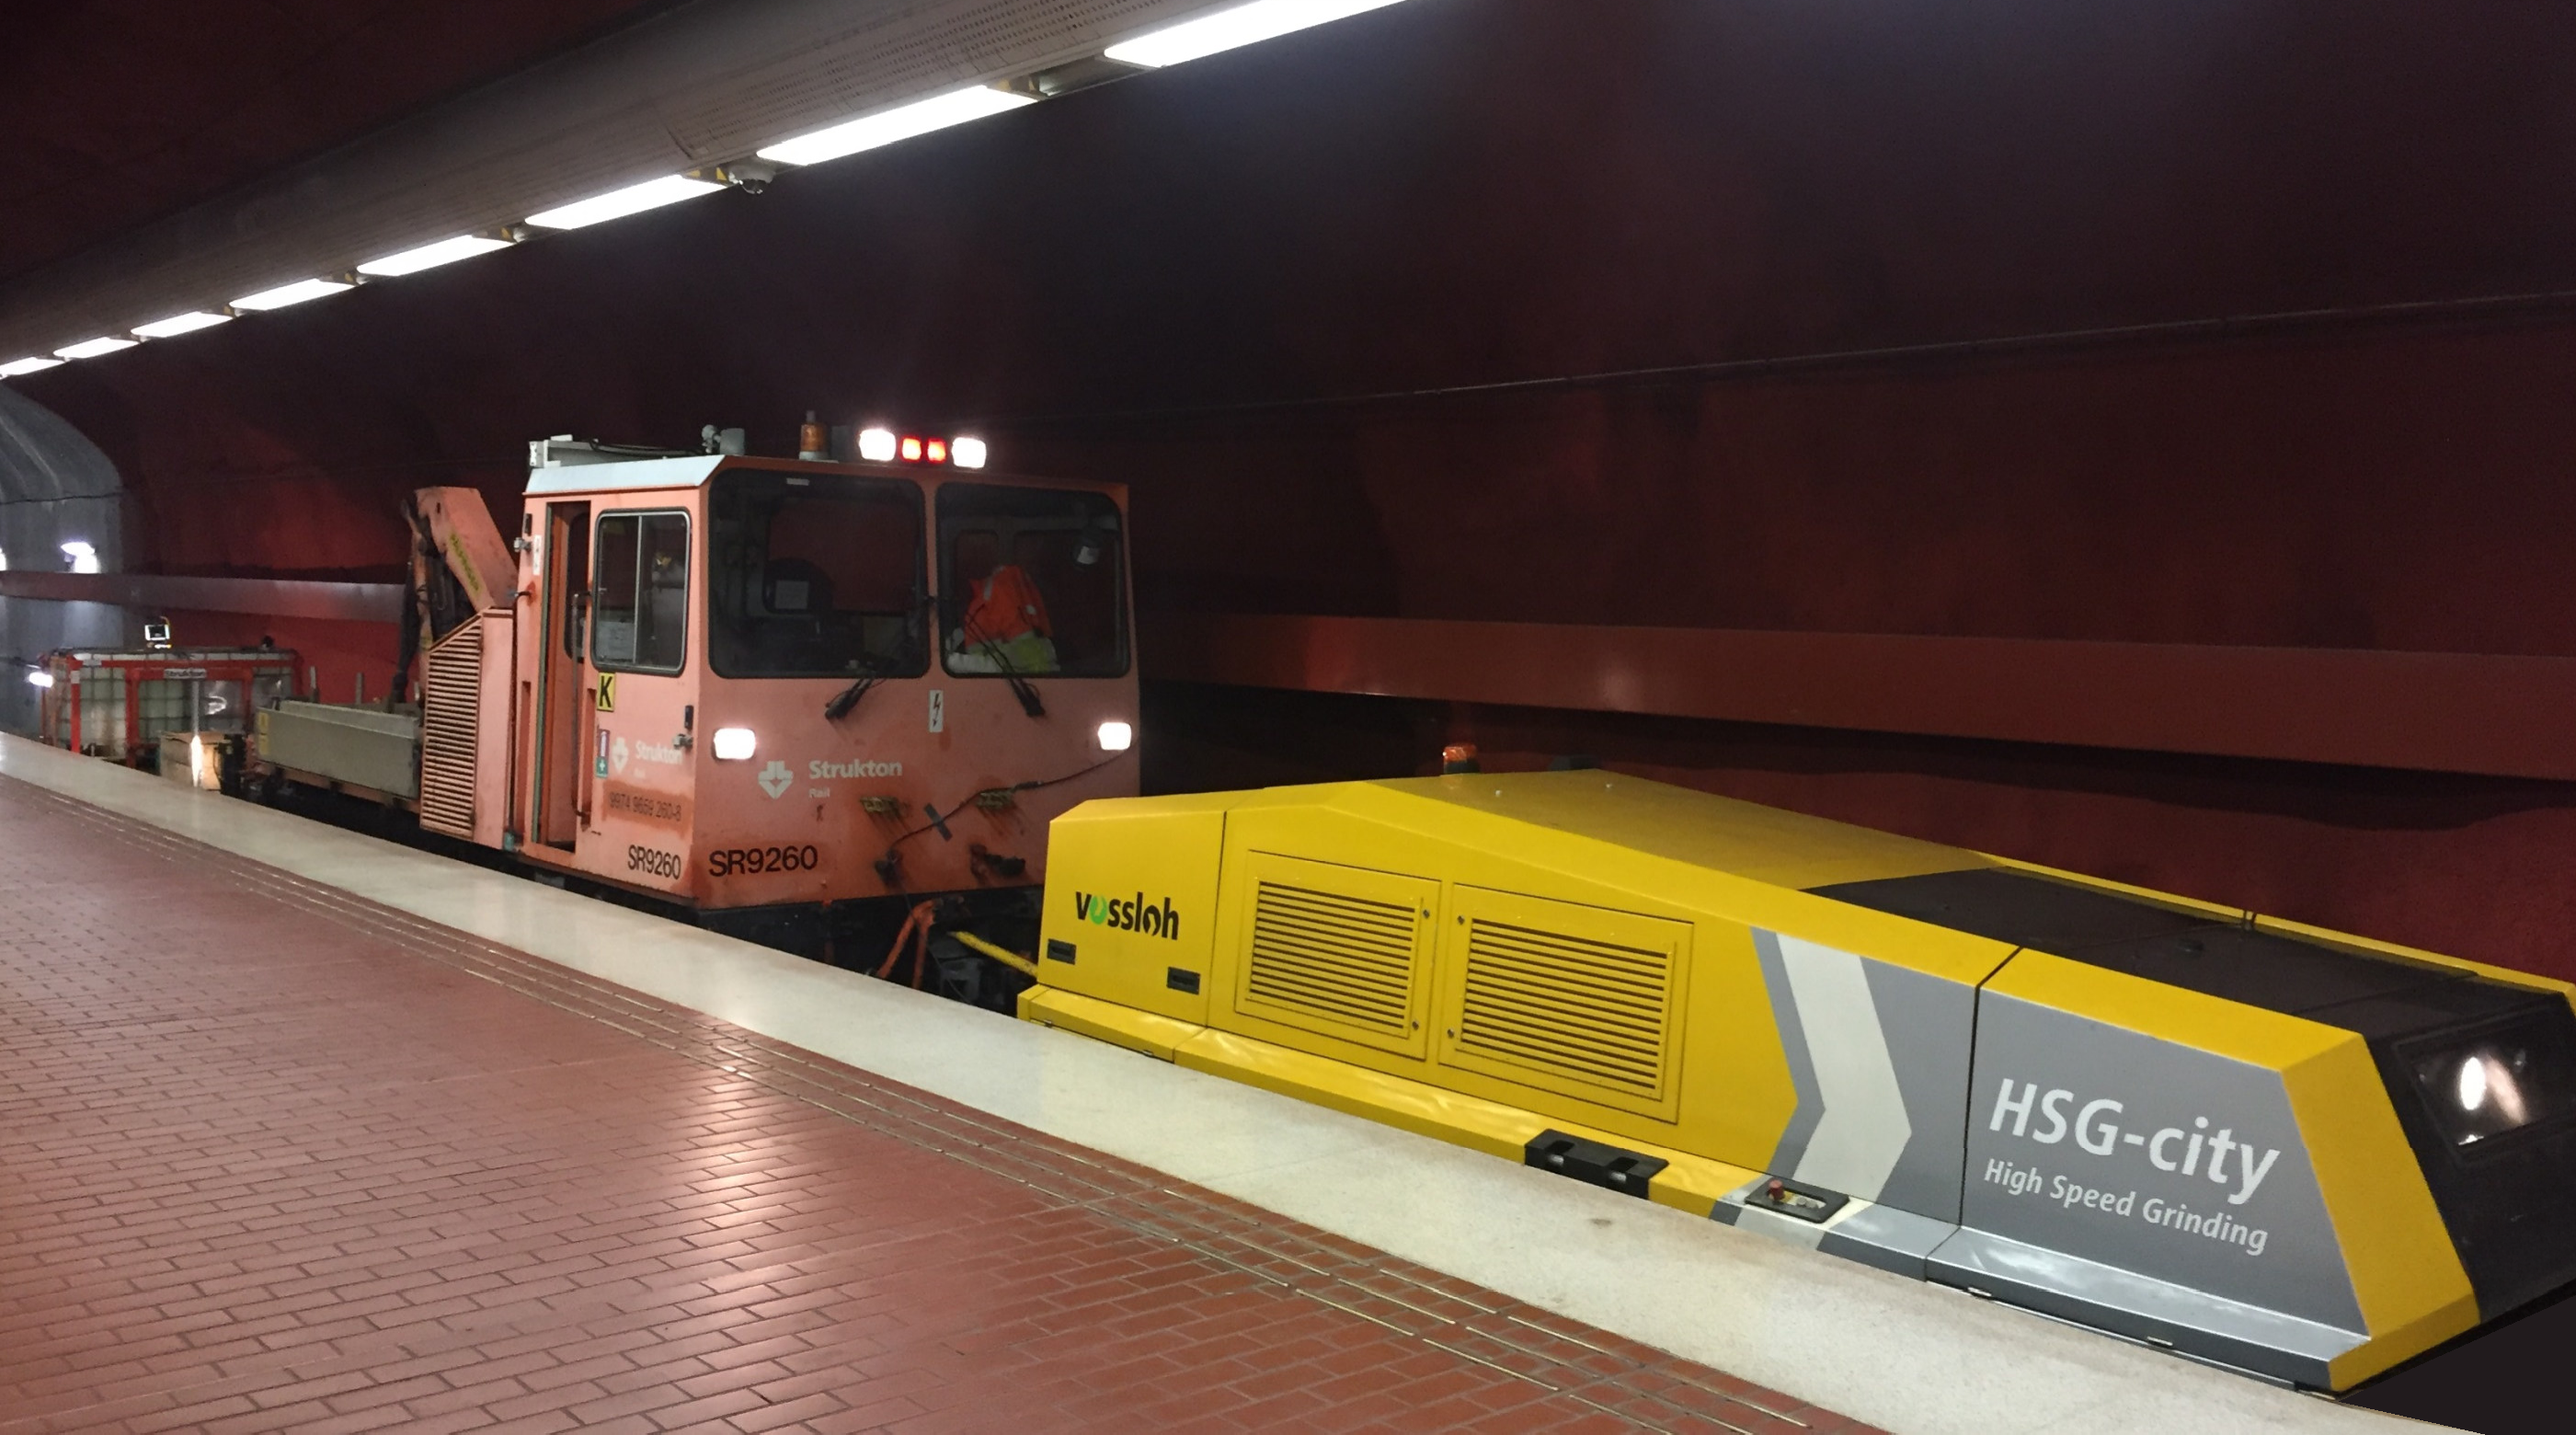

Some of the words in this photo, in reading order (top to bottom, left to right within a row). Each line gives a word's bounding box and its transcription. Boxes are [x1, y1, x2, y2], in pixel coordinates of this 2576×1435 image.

[600, 676, 613, 707] K
[808, 759, 902, 779] Strukton
[808, 787, 830, 798] Rail
[628, 844, 681, 879] SR9260
[708, 844, 819, 877] SR9260
[1075, 890, 1179, 940] vossloh
[1989, 1078, 2281, 1205] HSG-city
[1984, 1158, 2043, 1195] High
[2050, 1175, 2136, 1216] Speed
[2142, 1198, 2268, 1257] Grinding
